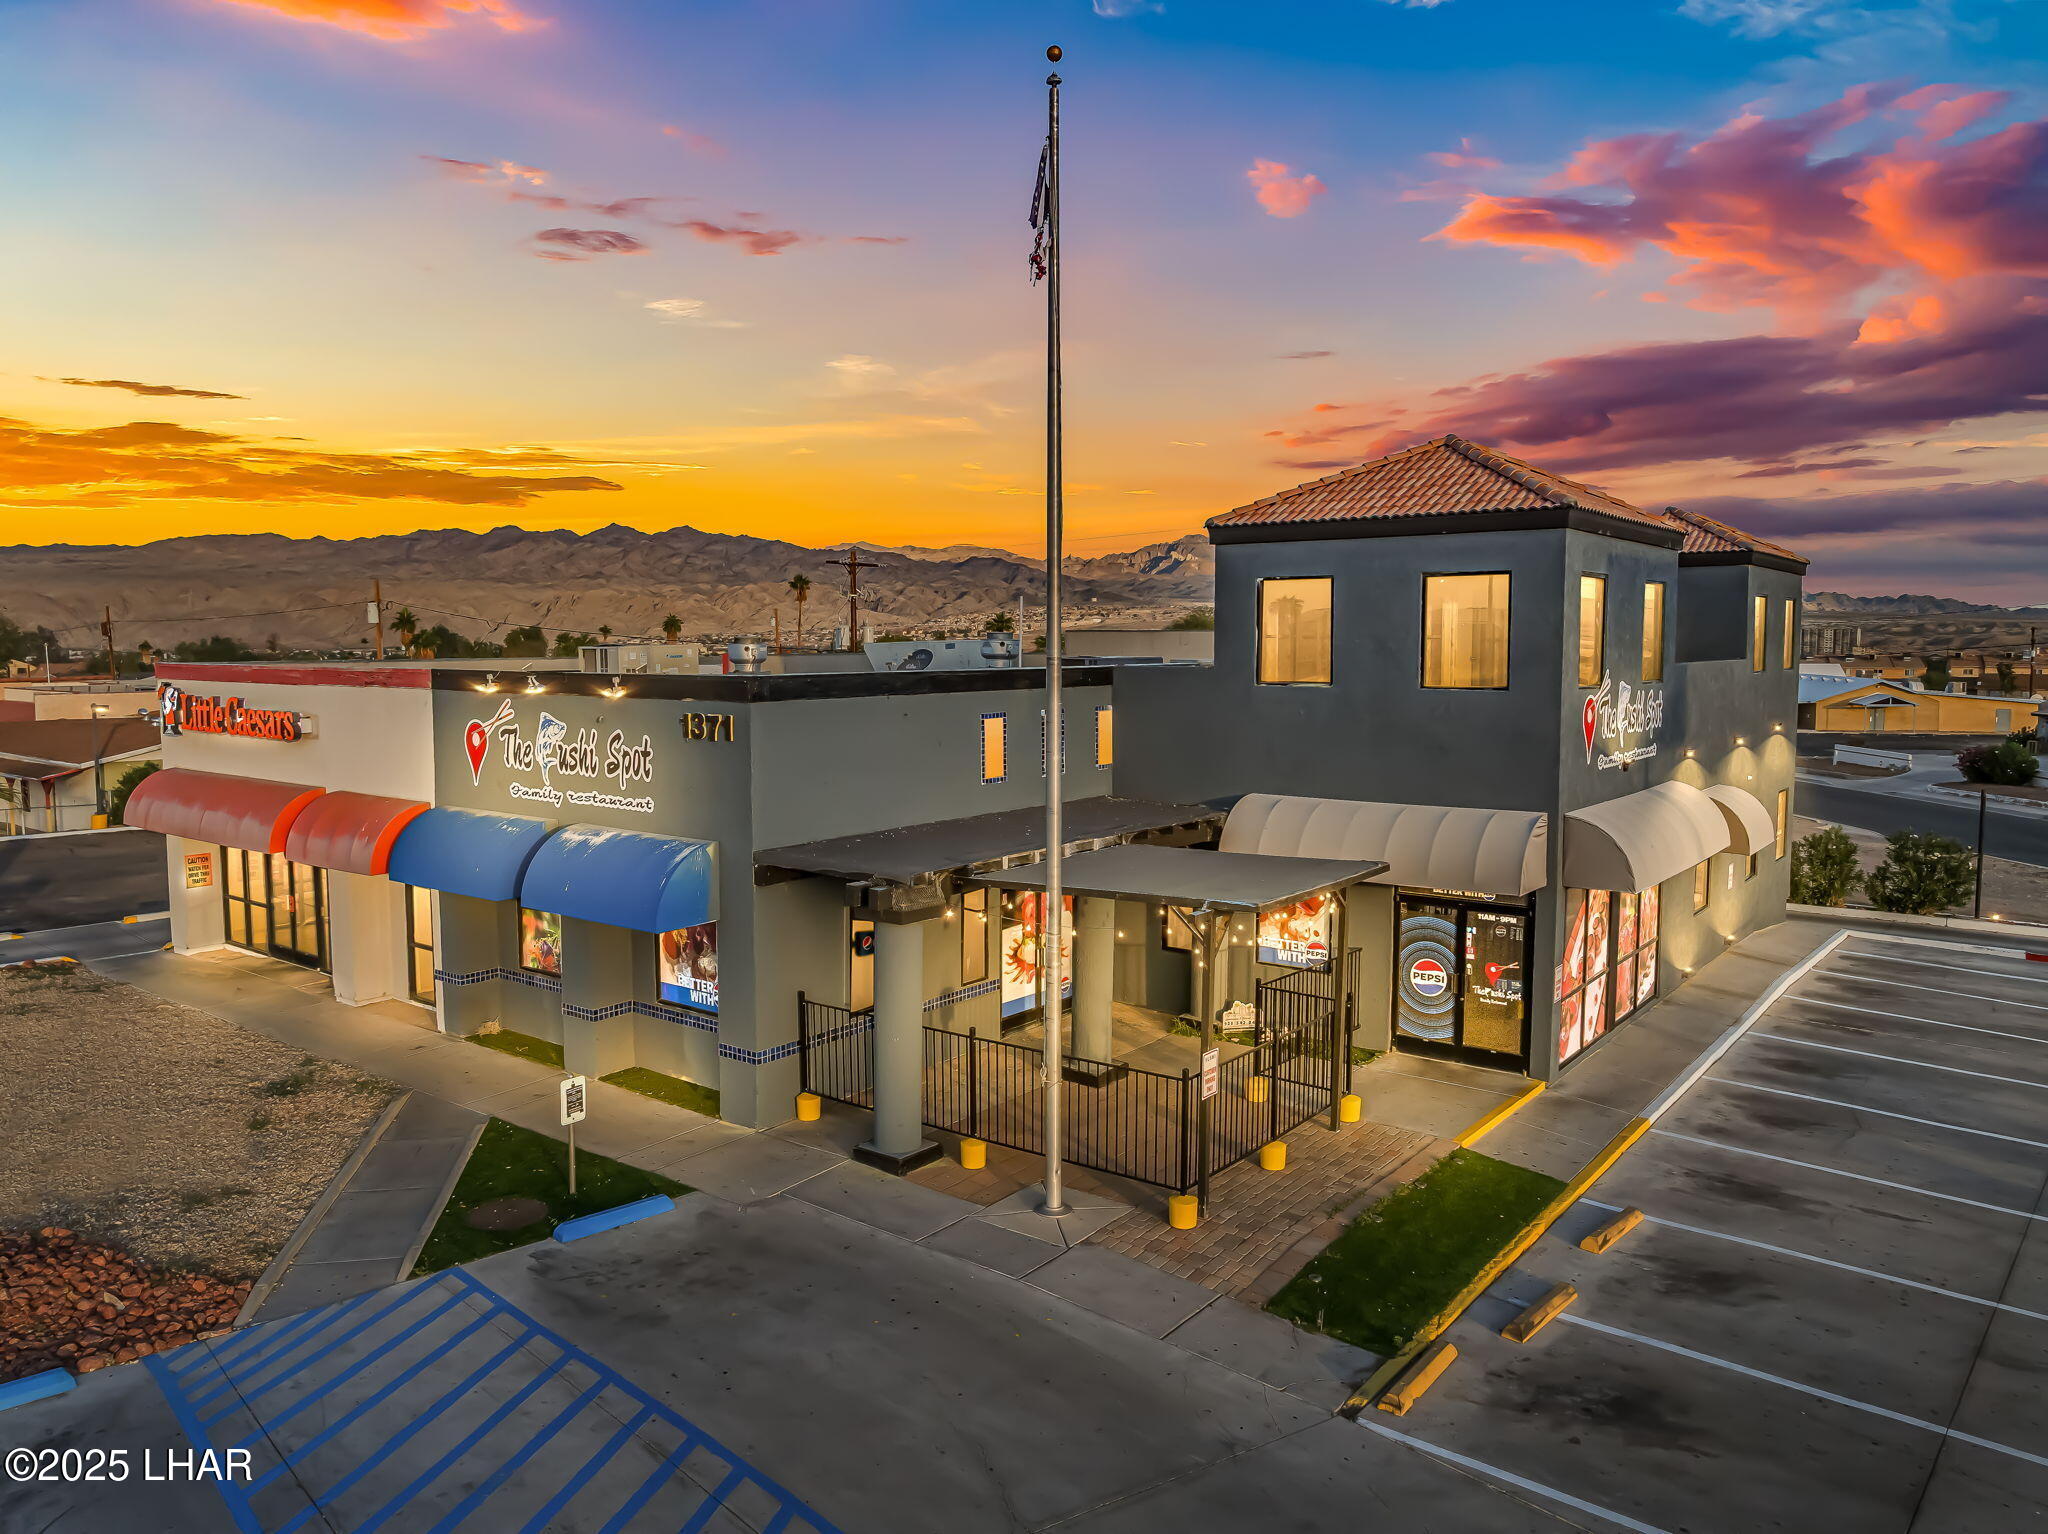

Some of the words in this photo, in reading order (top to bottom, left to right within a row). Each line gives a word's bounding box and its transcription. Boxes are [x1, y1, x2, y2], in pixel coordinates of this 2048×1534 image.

[180, 693, 223, 733] Little
[225, 697, 295, 741] Caesars
[680, 713, 734, 742] 1371
[499, 725, 533, 771] The
[605, 729, 654, 790] Spot
[510, 782, 562, 807] Family
[567, 789, 655, 812] restaurant
[187, 856, 208, 864] CAUTION
[1278, 948, 1307, 964] WITH
[1306, 950, 1327, 958] PEPSI
[678, 973, 714, 993] BETTER
[1413, 972, 1445, 983] PEPSI
[690, 989, 715, 1006] WITH
